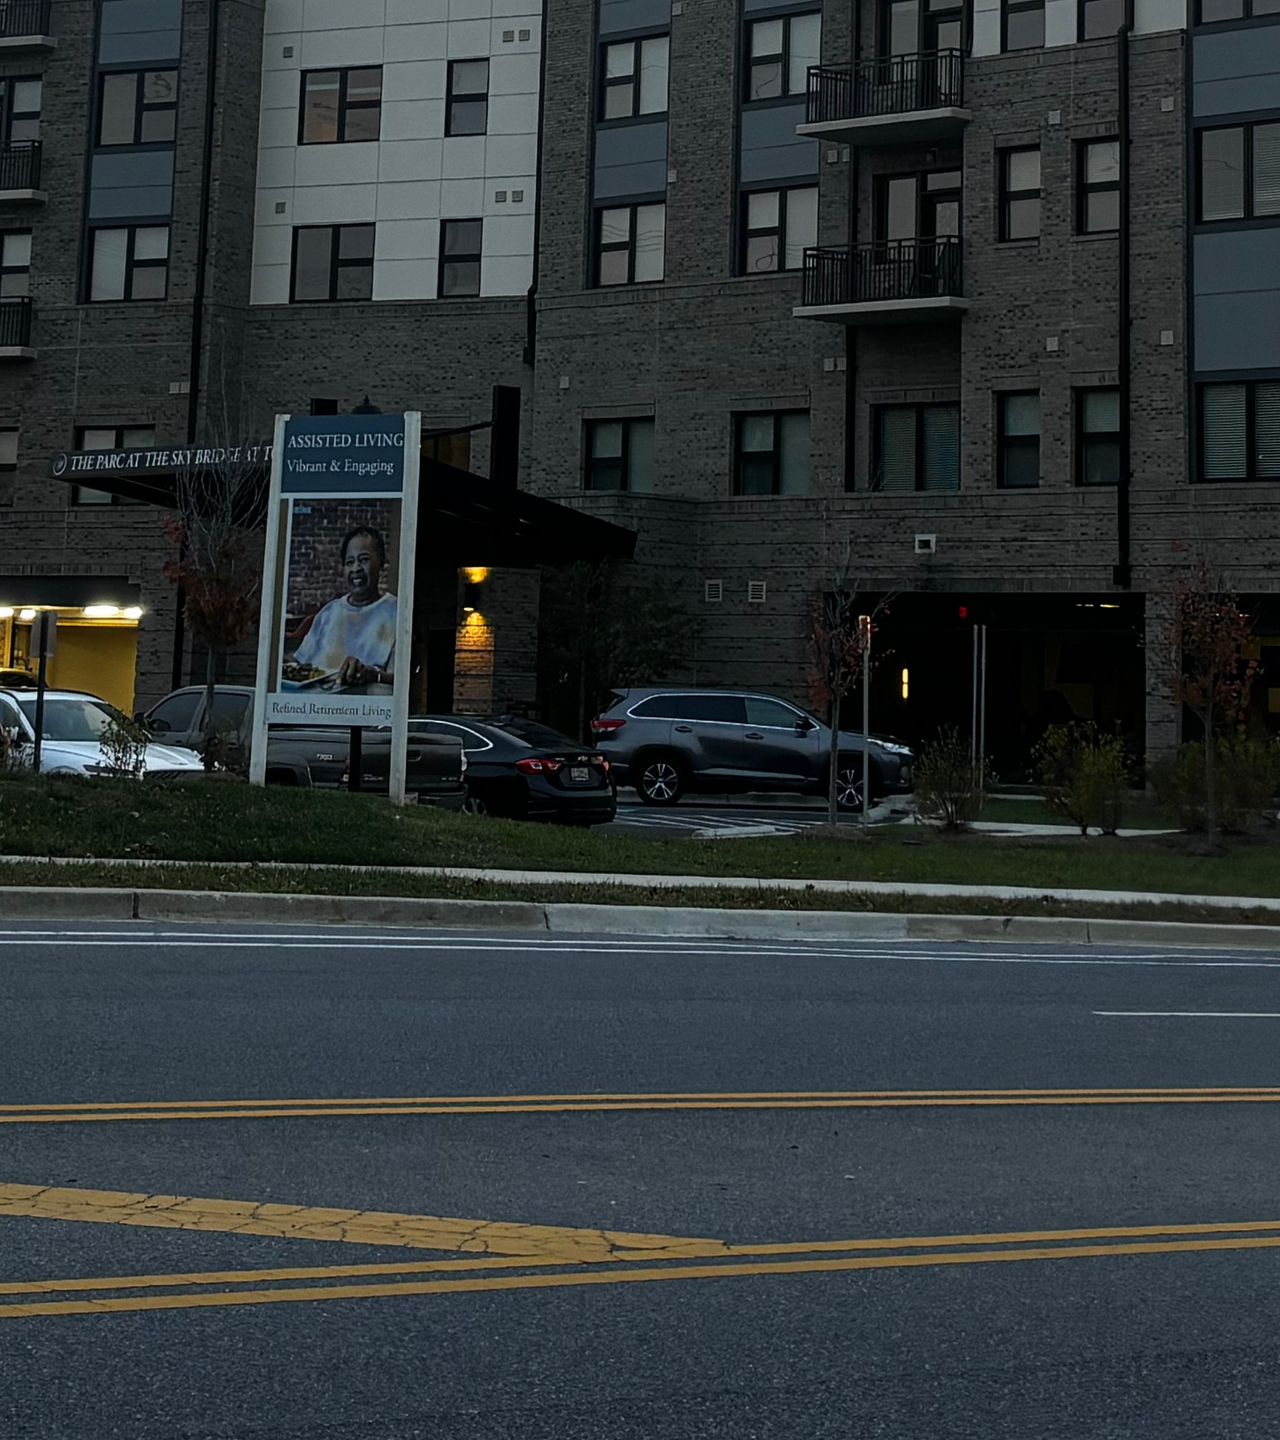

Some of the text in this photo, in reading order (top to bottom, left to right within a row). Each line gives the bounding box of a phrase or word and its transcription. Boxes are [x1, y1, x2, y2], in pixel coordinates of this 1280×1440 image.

[288, 433, 404, 448] ASSISTED LIVING
[71, 455, 95, 470] THE
[95, 454, 126, 469] PARC
[126, 453, 142, 468] AT
[144, 451, 170, 467] THE
[170, 449, 194, 465] SKY
[287, 459, 394, 475] Vibrant & Engaging
[272, 702, 391, 720] Refined Retirement Living
